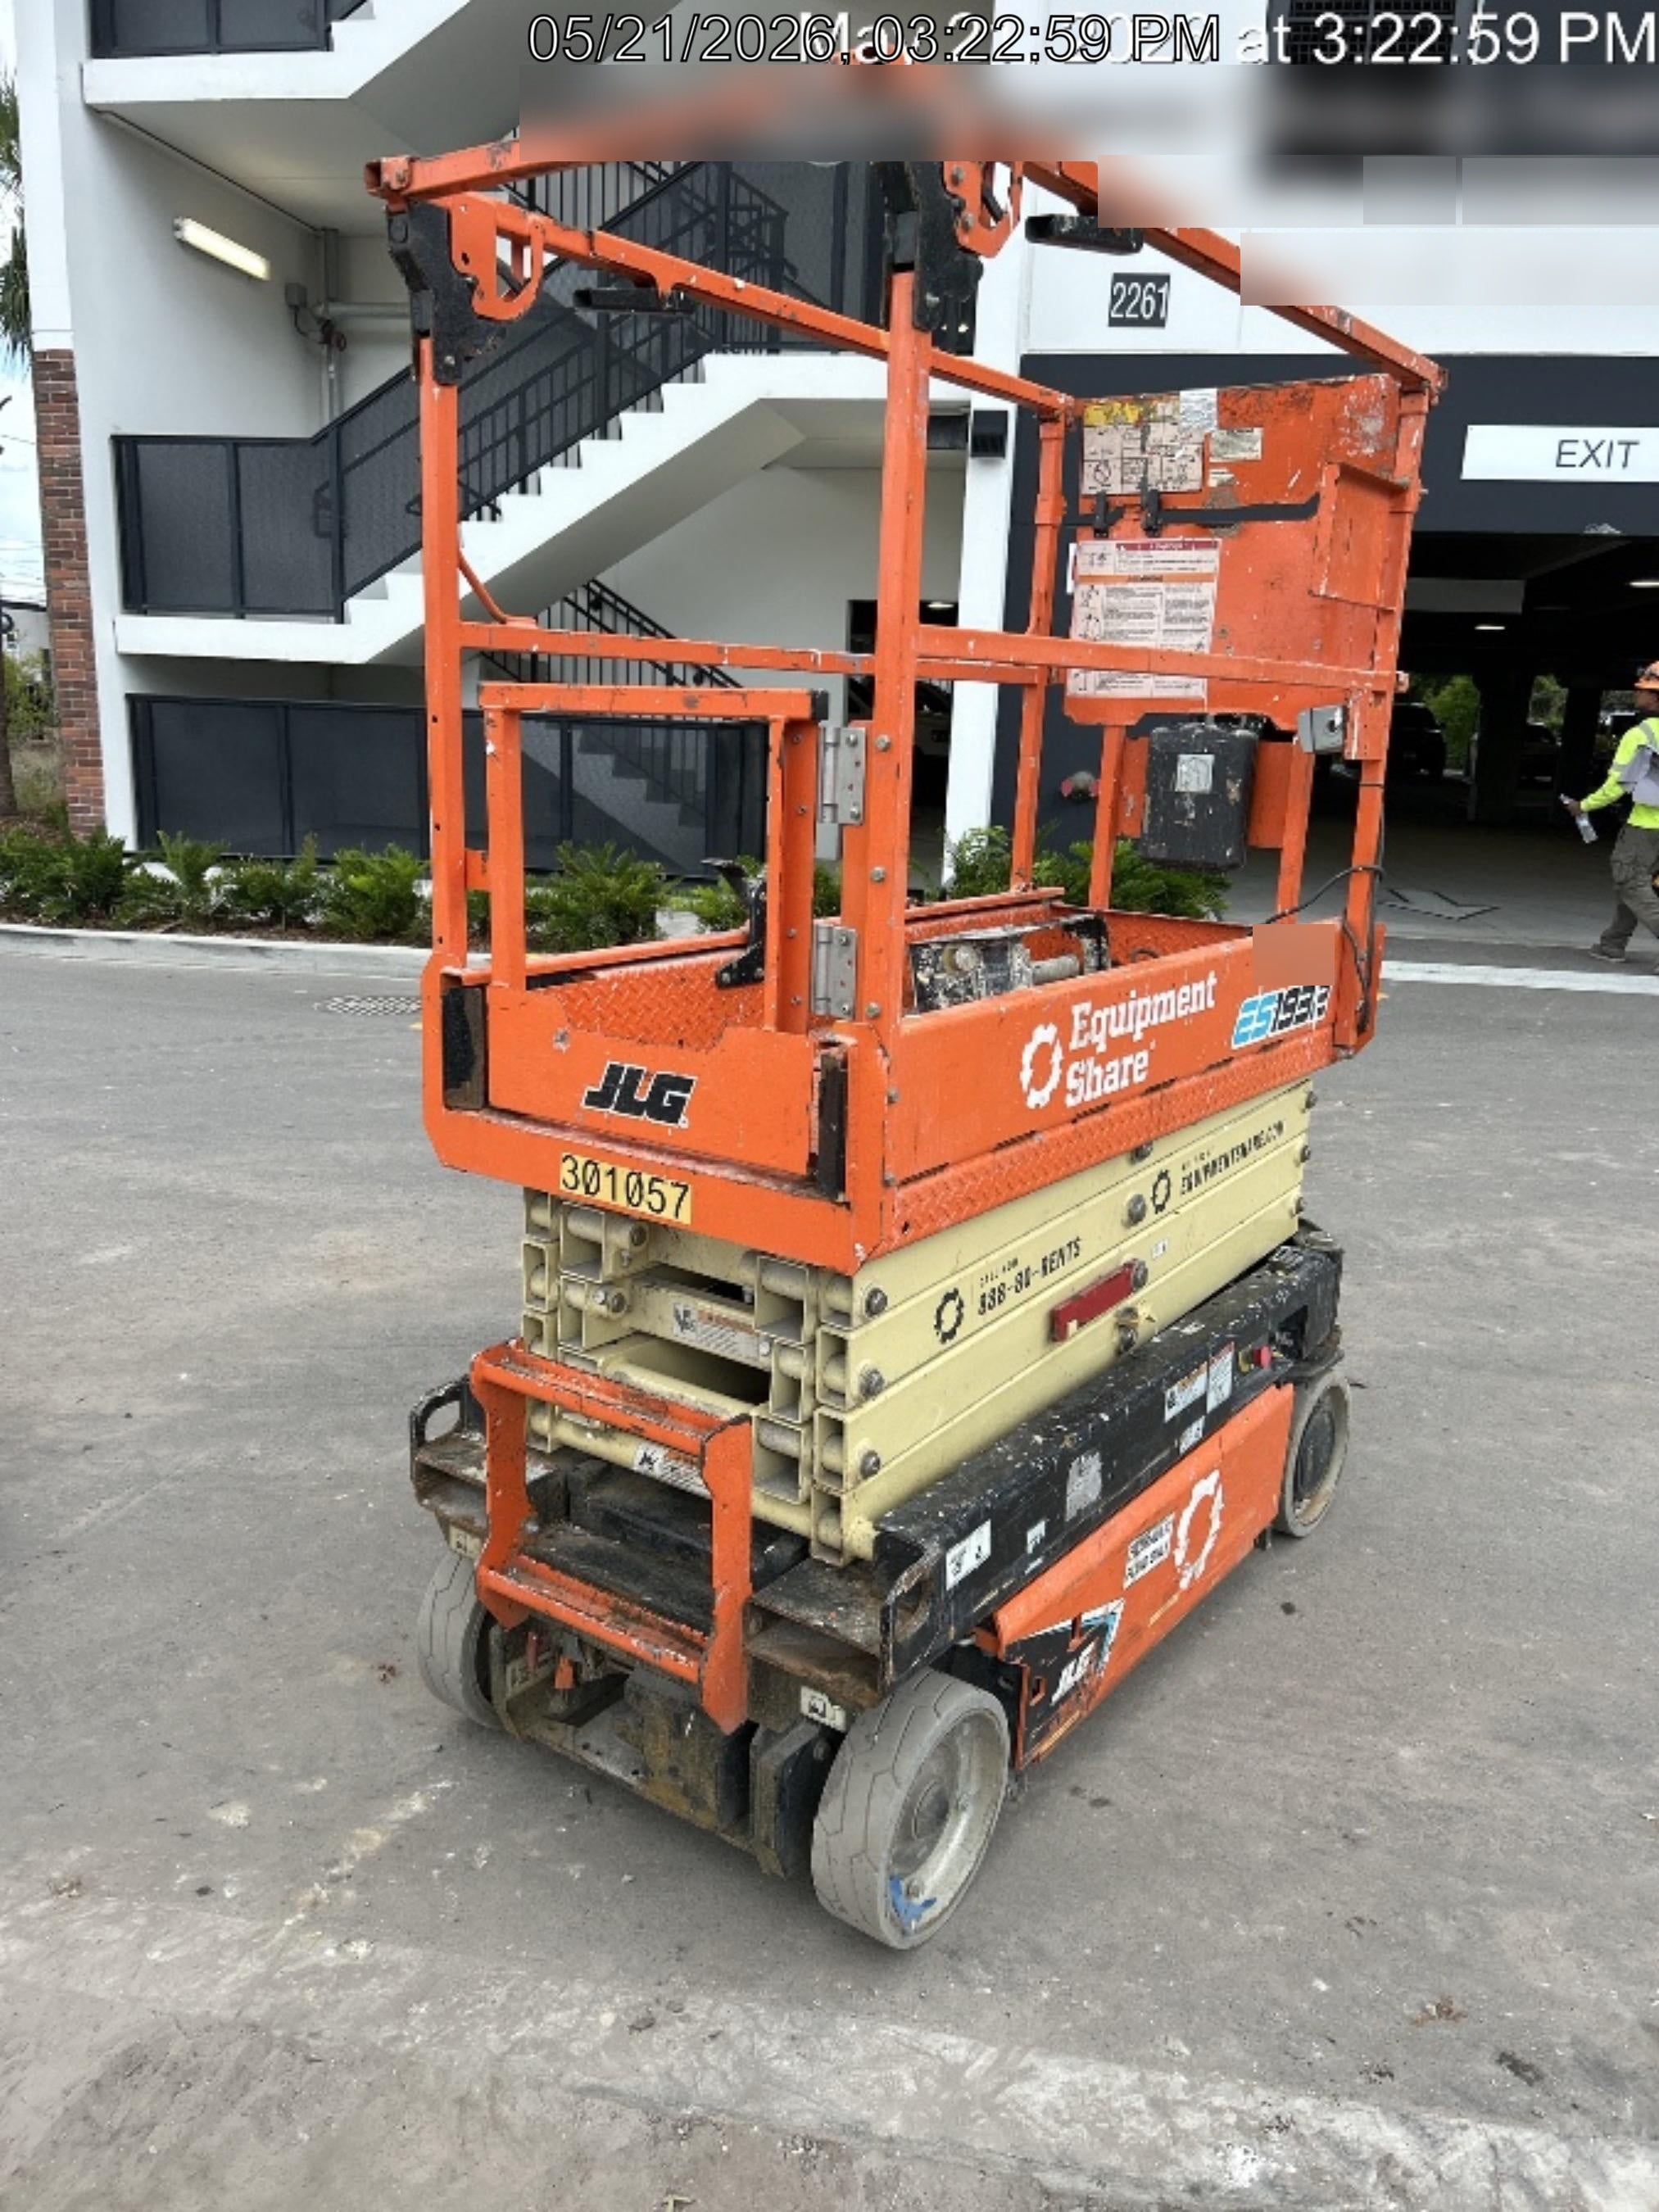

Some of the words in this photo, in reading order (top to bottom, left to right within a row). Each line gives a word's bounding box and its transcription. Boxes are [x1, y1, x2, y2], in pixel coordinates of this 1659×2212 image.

[1110, 281, 1169, 320] 2261
[1555, 439, 1641, 469] EXIT
[1068, 970, 1218, 1054] Equipment
[582, 1062, 699, 1127] JLG
[1066, 1049, 1150, 1108] Share
[561, 1154, 690, 1220] 301057
